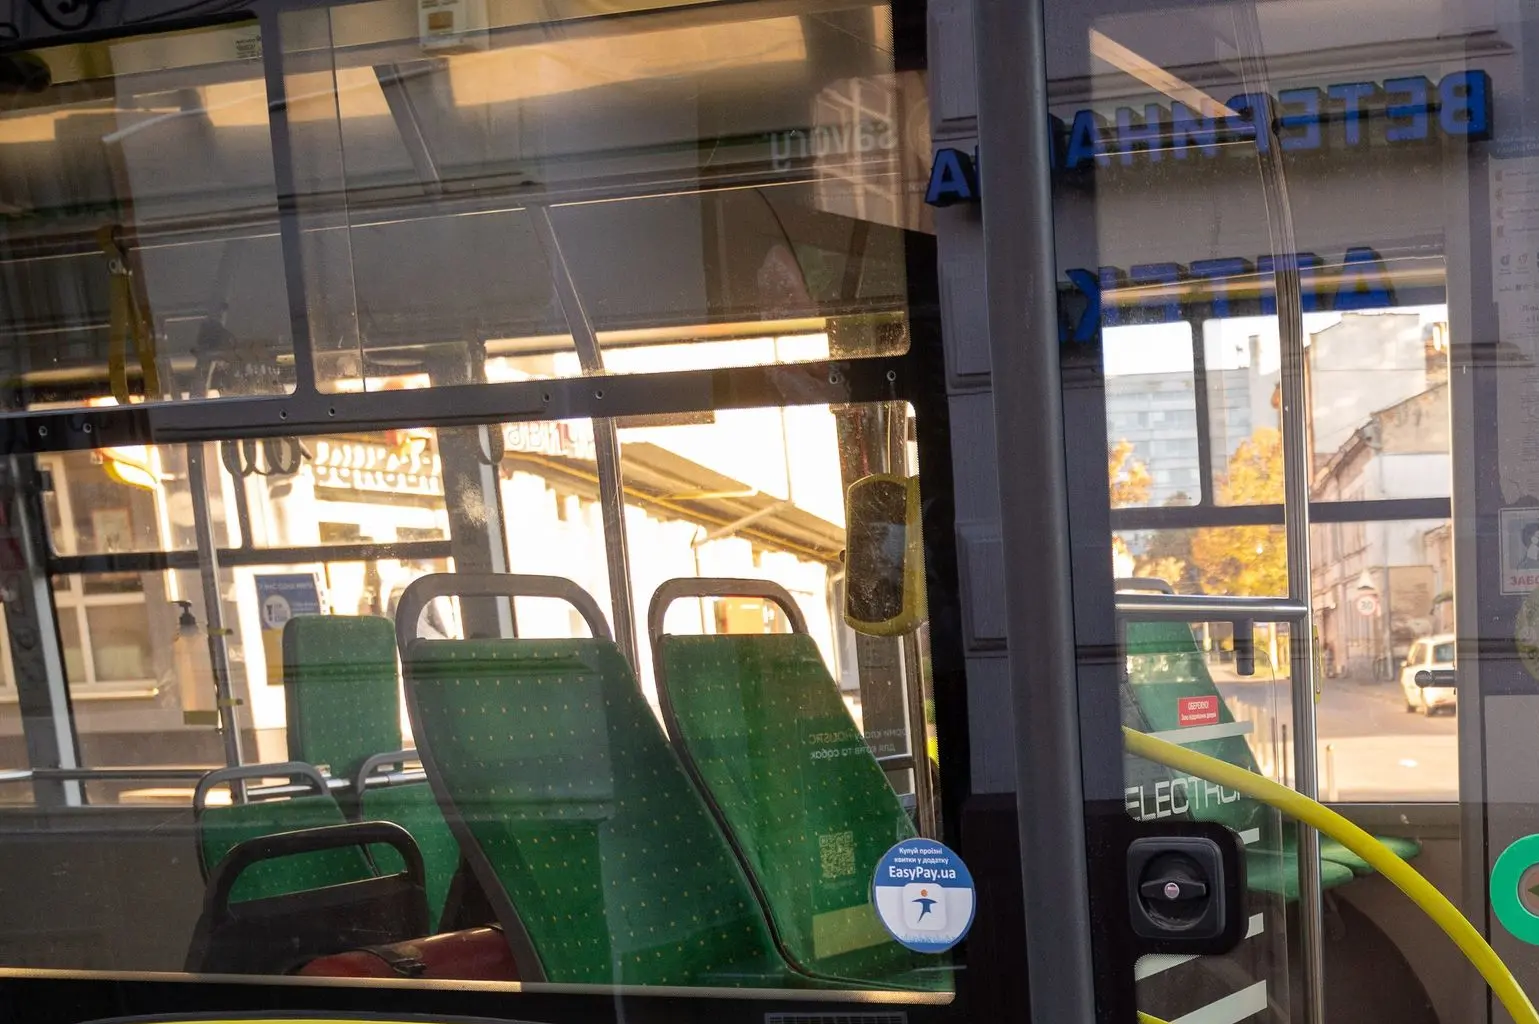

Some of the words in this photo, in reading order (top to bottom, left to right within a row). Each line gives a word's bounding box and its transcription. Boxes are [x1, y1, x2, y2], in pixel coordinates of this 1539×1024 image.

[899, 847, 918, 855] Купуй
[920, 847, 943, 855] проїзні
[922, 857, 949, 865] додатку
[888, 865, 957, 881] EasyPay.ua
